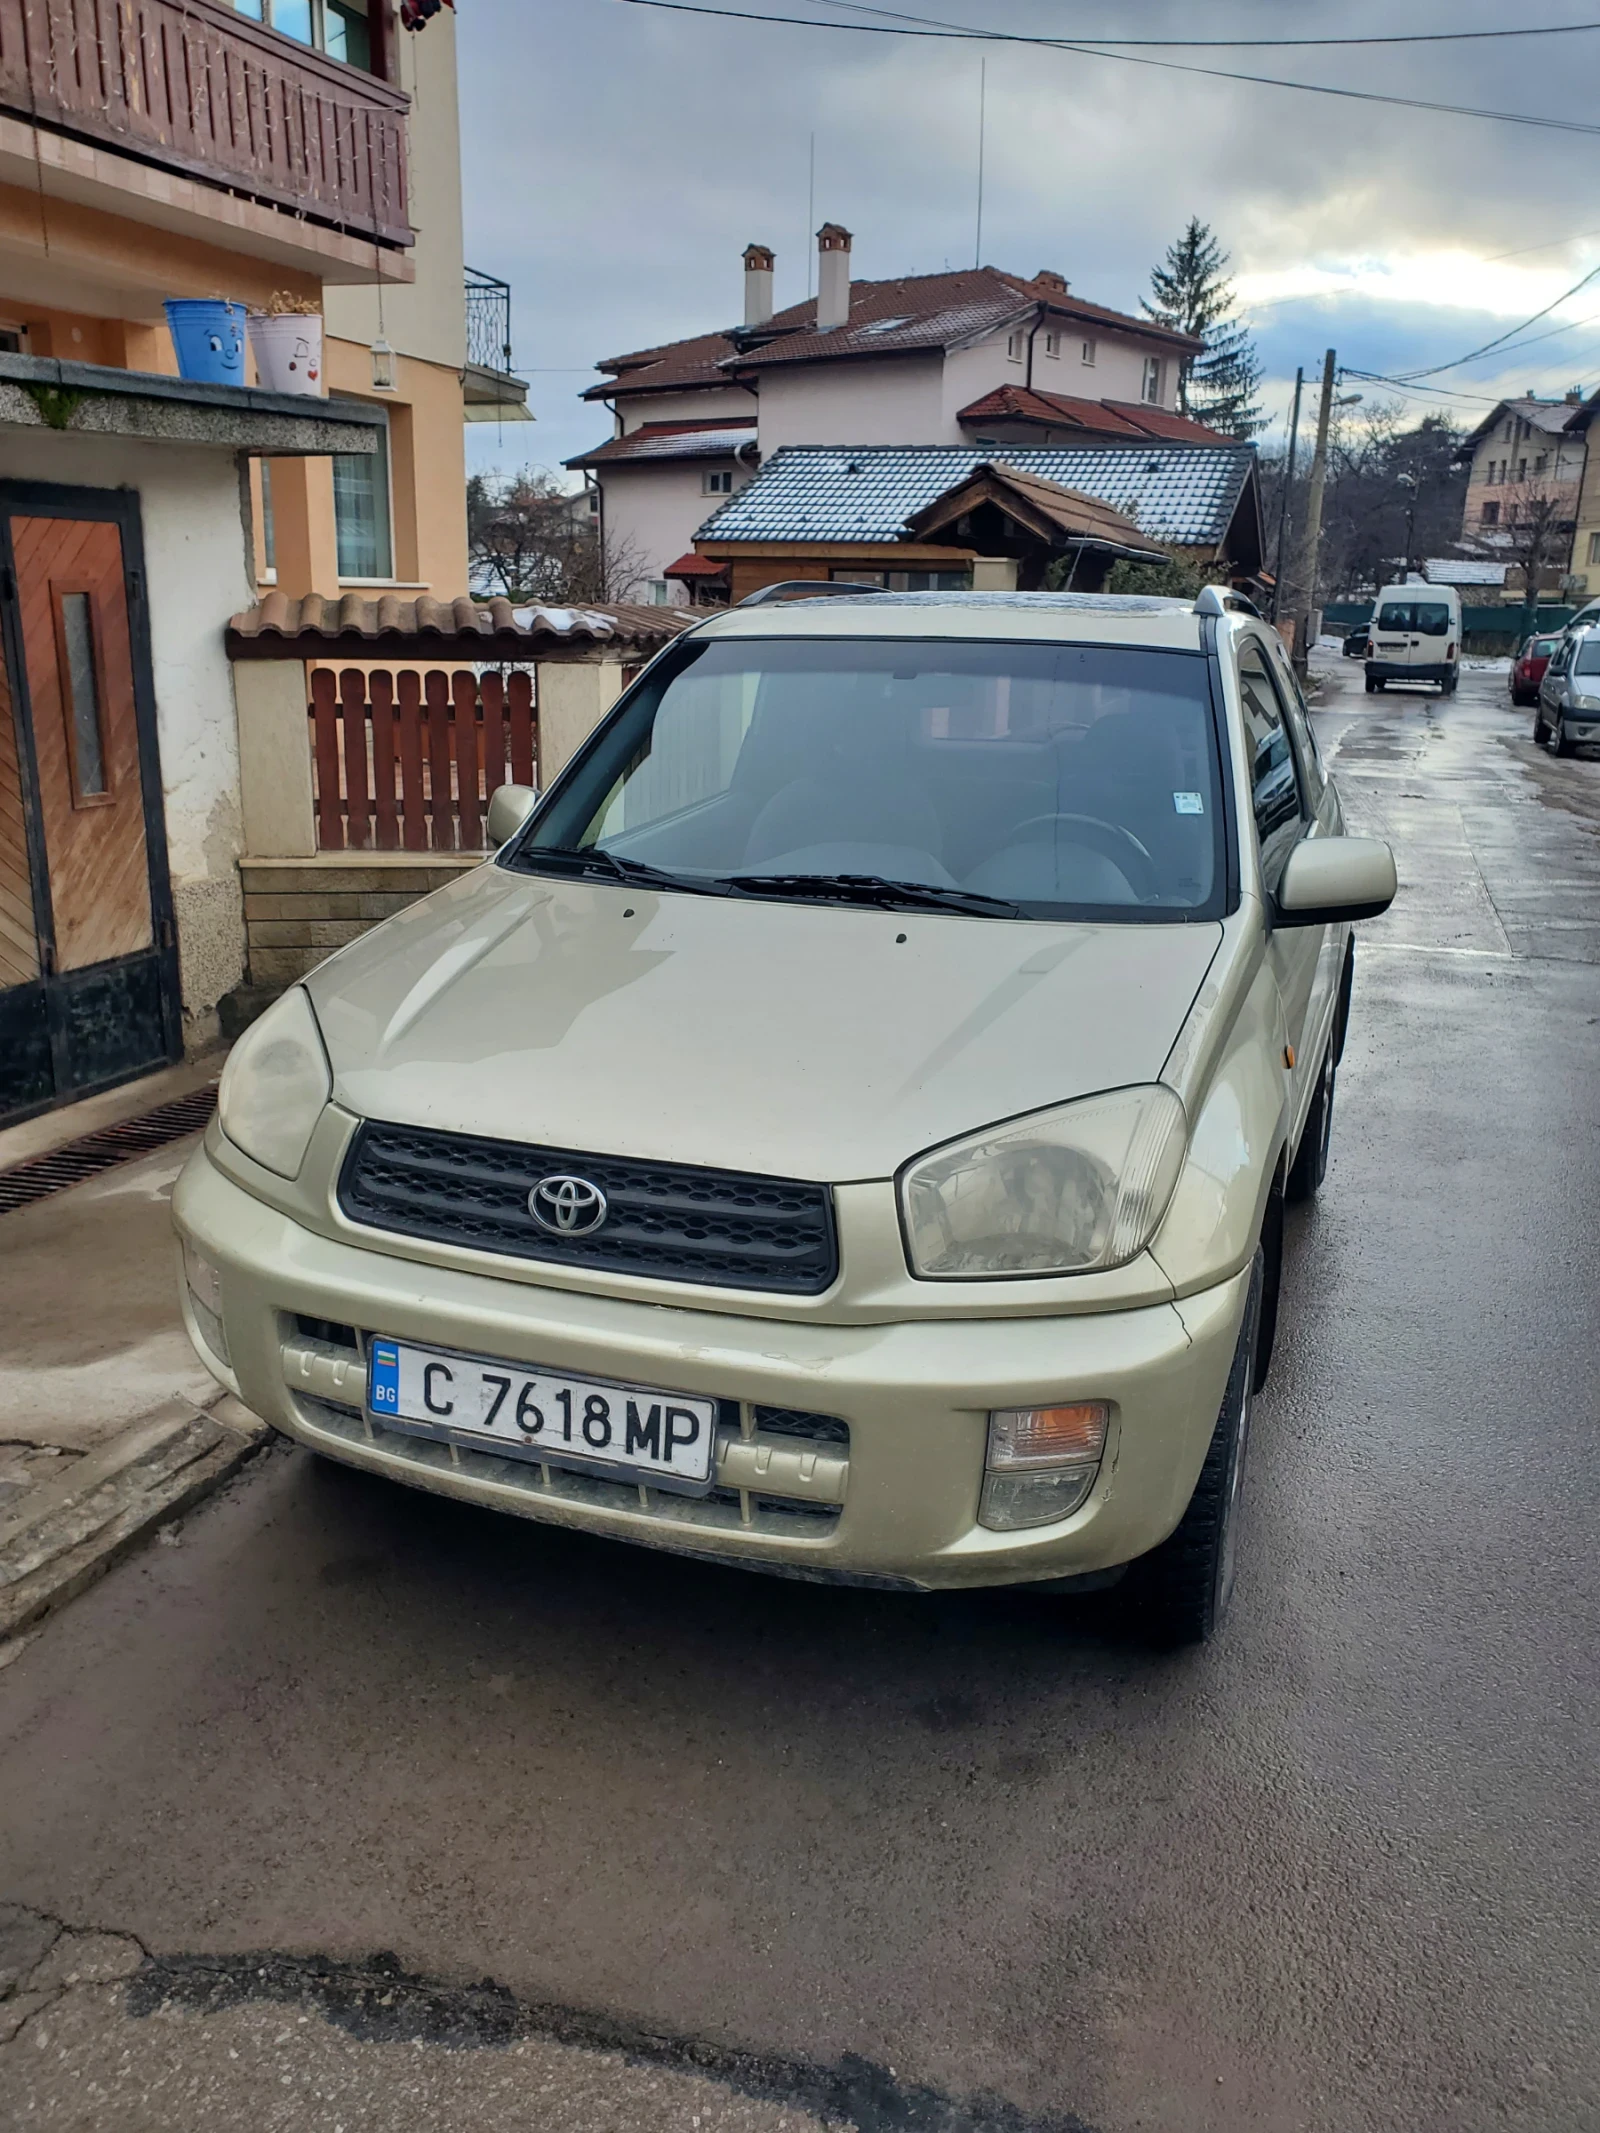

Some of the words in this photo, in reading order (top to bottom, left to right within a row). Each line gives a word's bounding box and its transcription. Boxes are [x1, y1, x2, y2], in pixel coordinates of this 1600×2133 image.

[375, 1384, 396, 1403] BG
[424, 1362, 453, 1416] C
[482, 1374, 611, 1447] 7618
[625, 1399, 700, 1462] MP
